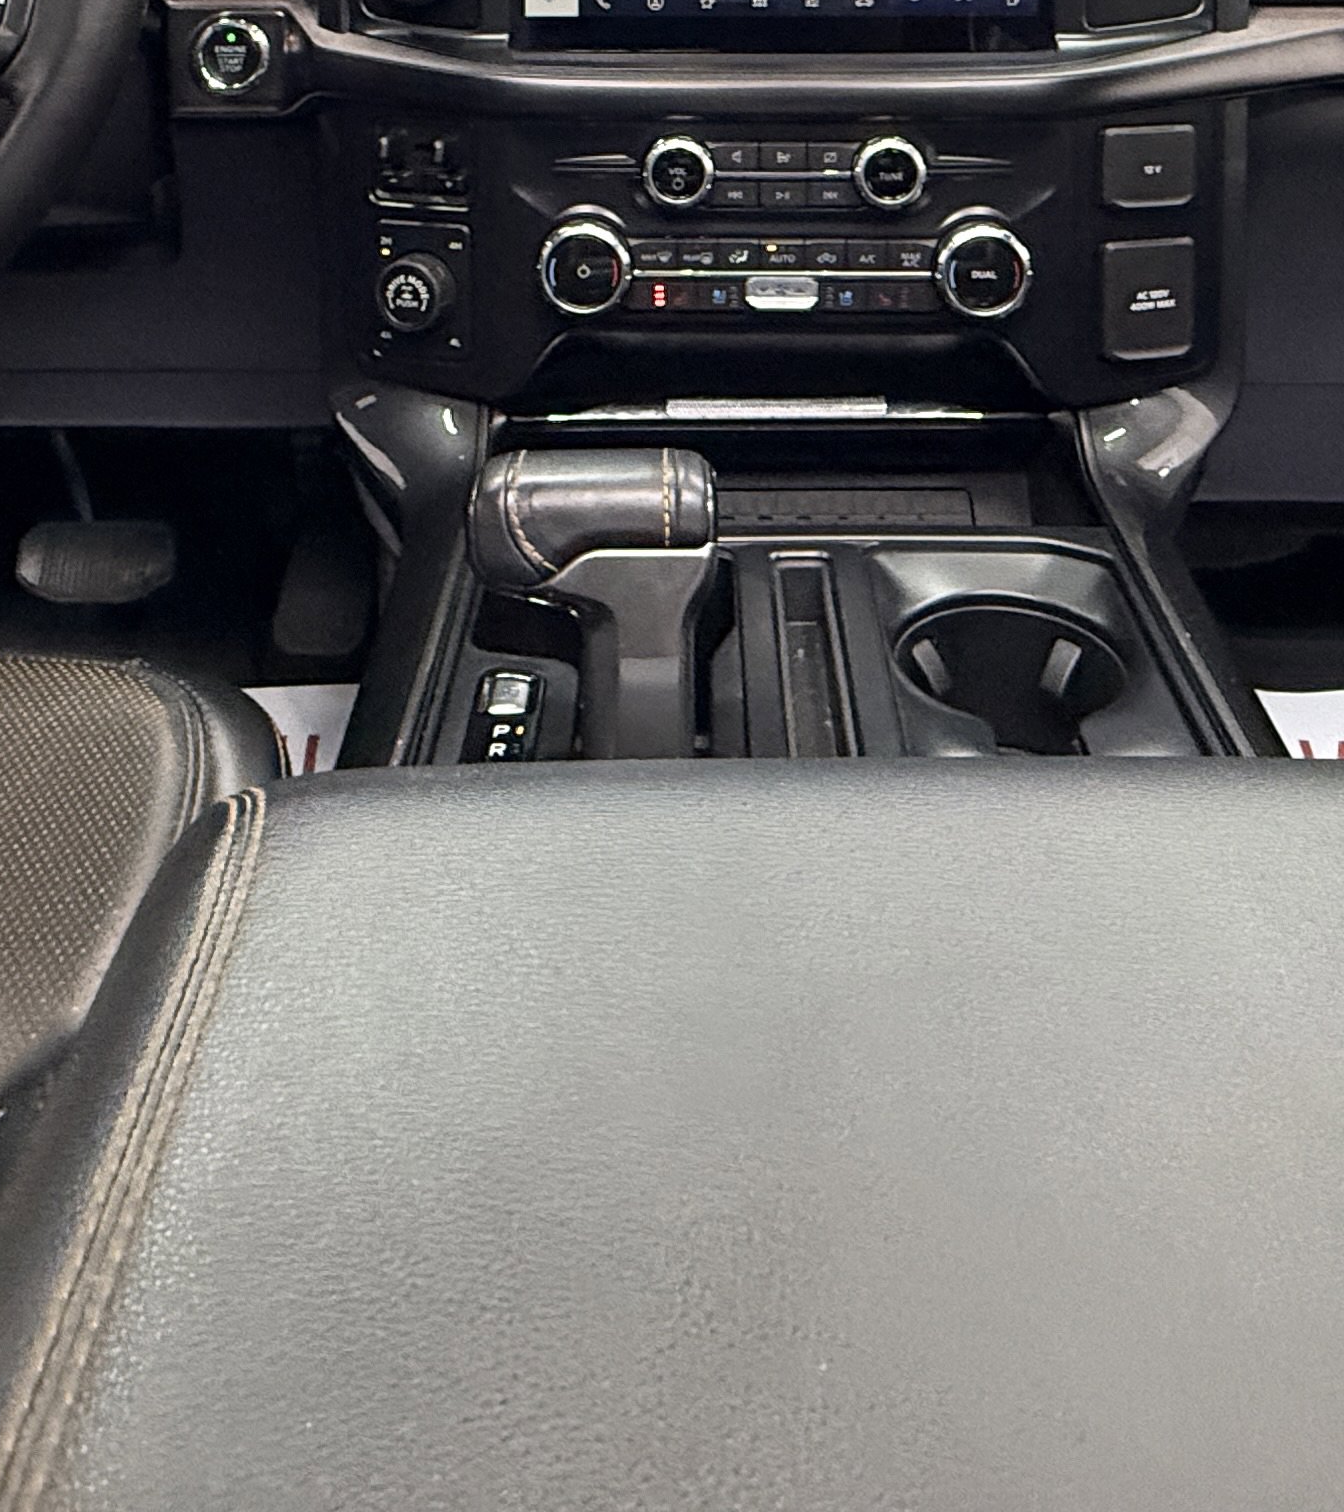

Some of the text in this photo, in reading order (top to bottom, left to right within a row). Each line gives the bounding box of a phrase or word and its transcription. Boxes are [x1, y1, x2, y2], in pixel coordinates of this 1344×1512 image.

[214, 45, 247, 54] ENGINE
[217, 57, 244, 66] START
[220, 65, 243, 74] STOP
[879, 172, 904, 181] TUNE
[769, 254, 796, 263] AUTO
[859, 254, 876, 264] A/C
[970, 270, 997, 280] DUAL
[492, 724, 512, 739] P
[488, 742, 507, 757] R
